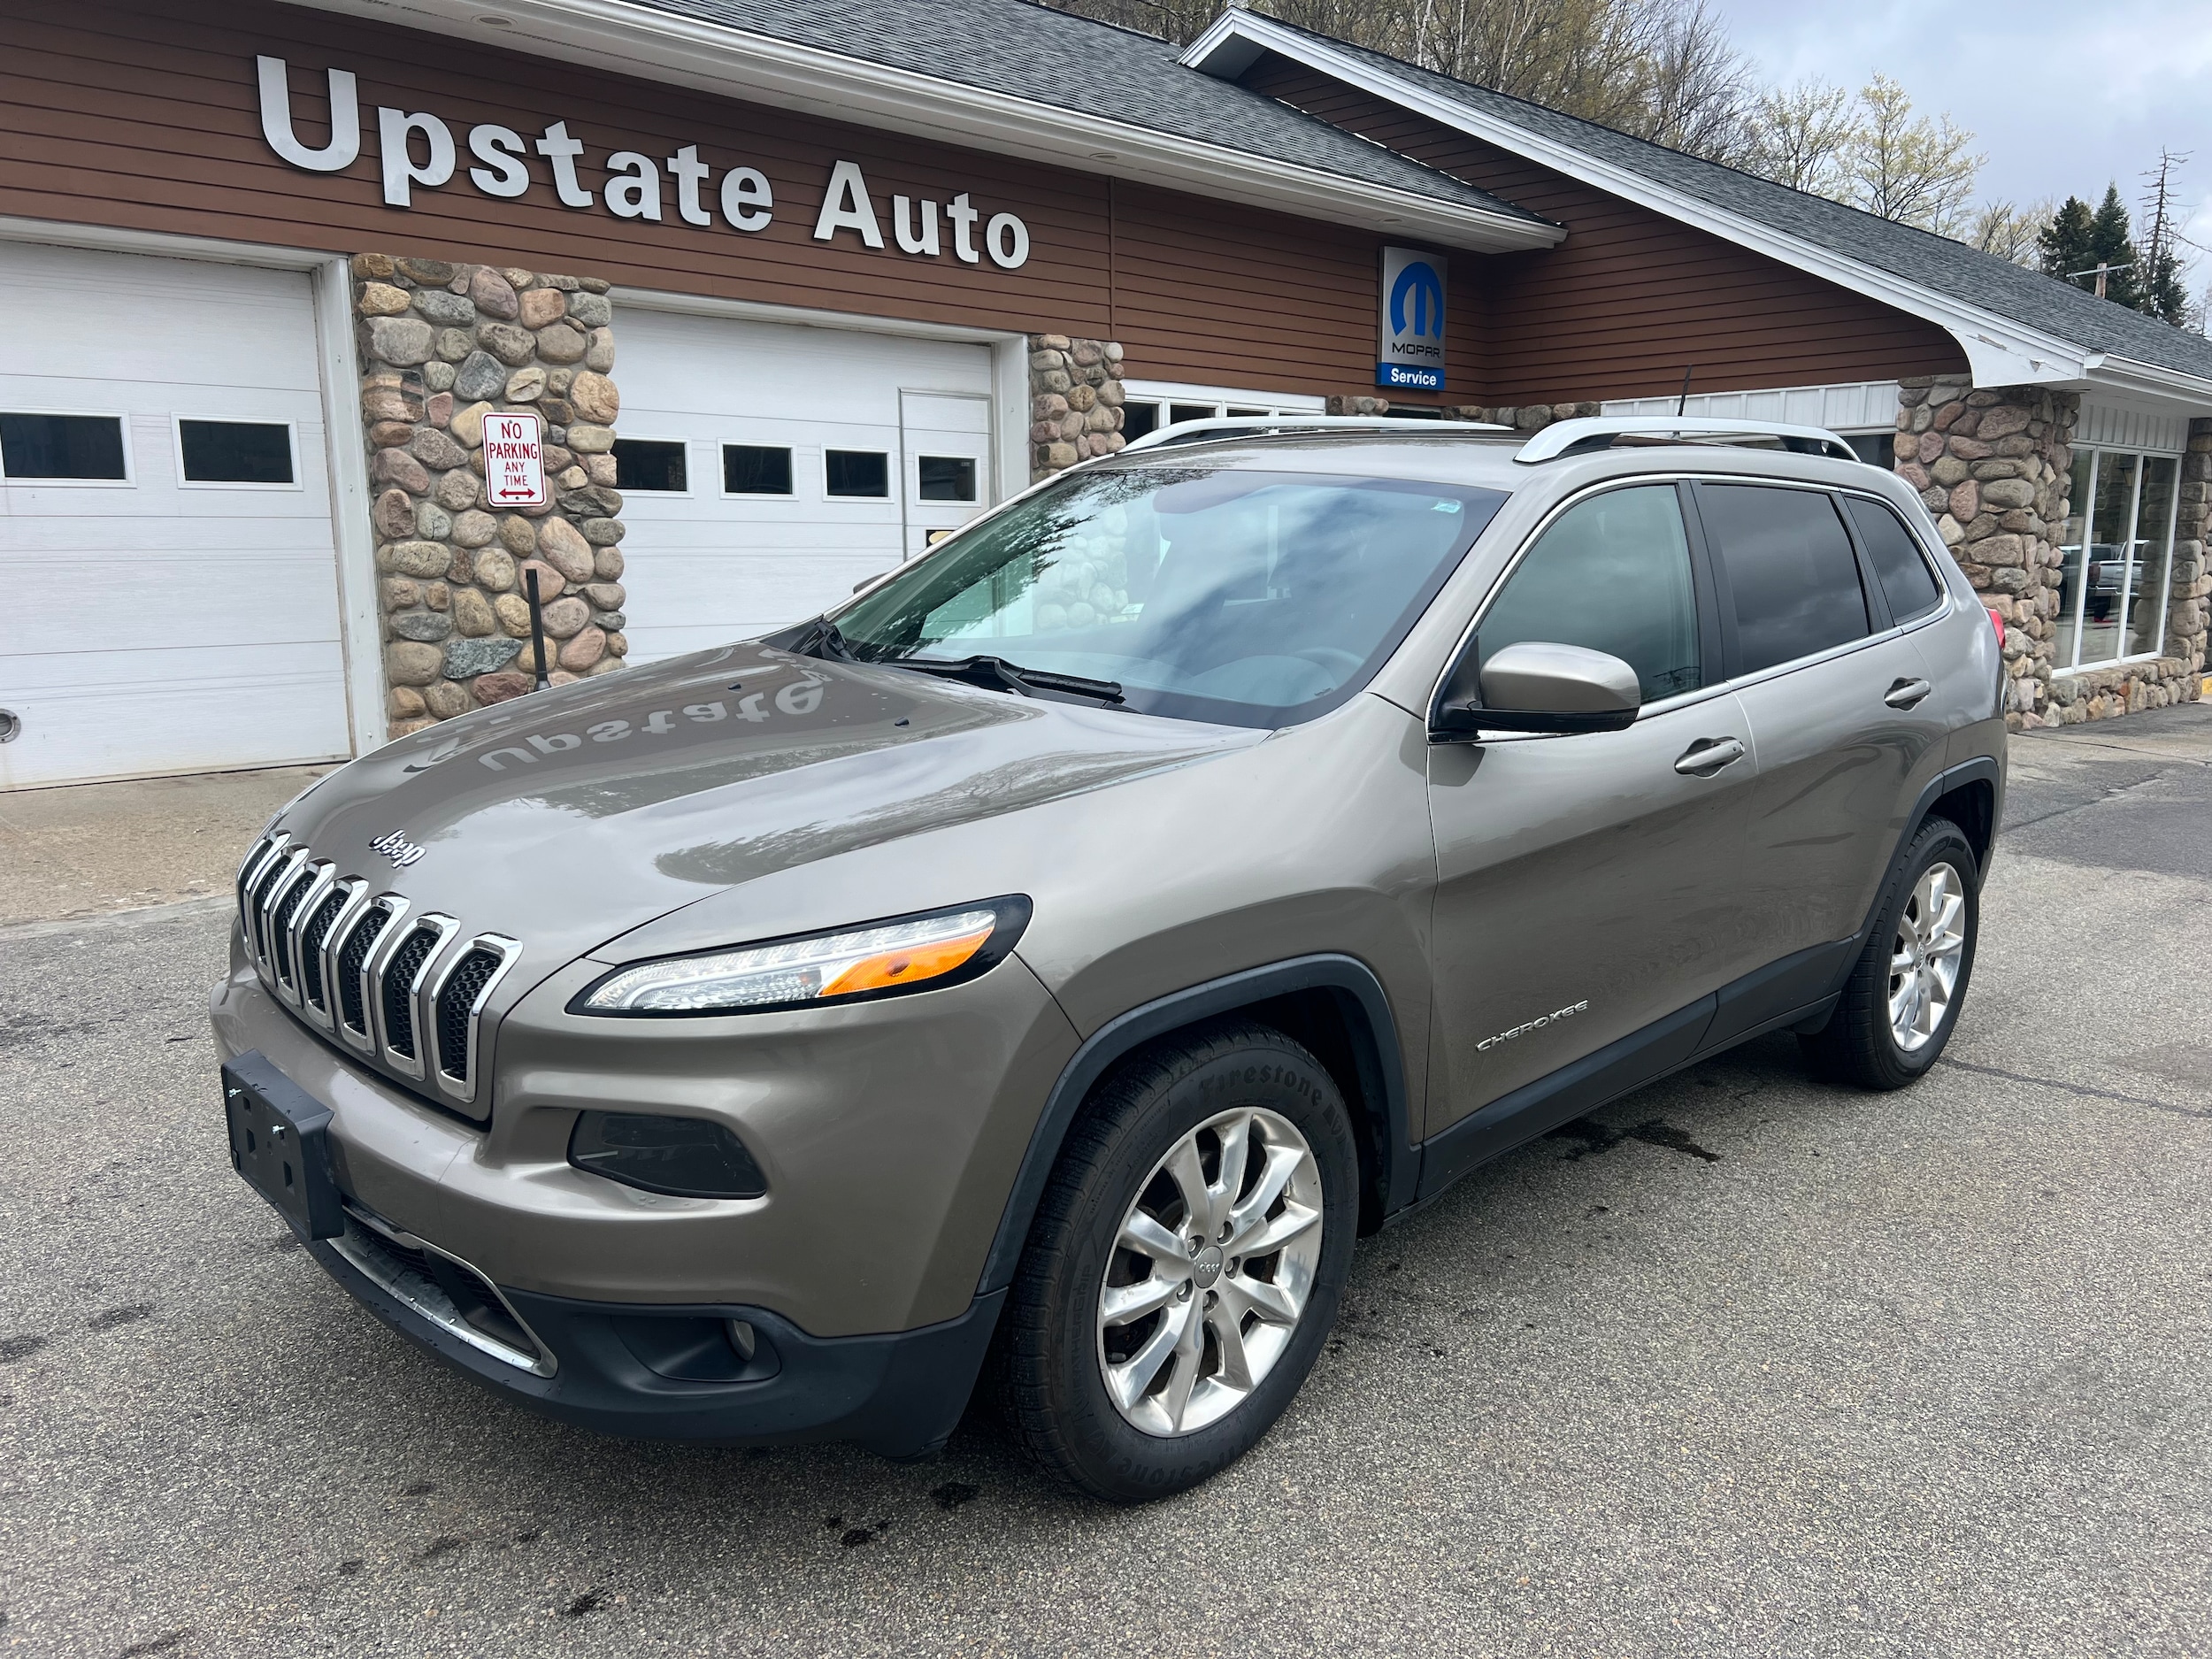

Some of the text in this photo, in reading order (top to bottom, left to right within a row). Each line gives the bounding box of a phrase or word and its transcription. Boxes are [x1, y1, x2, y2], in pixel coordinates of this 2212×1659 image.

[255, 54, 1032, 271] Upstate Auto
[1392, 342, 1440, 358] MOPAR
[1391, 367, 1437, 386] Service
[501, 422, 522, 439] NO
[488, 442, 538, 459] PARKING
[504, 461, 526, 472] ANY
[503, 474, 528, 487] TIME
[368, 828, 426, 869] Jeep
[1475, 999, 1589, 1052] CHEROKEE
[1198, 1064, 1323, 1106] Firestone
